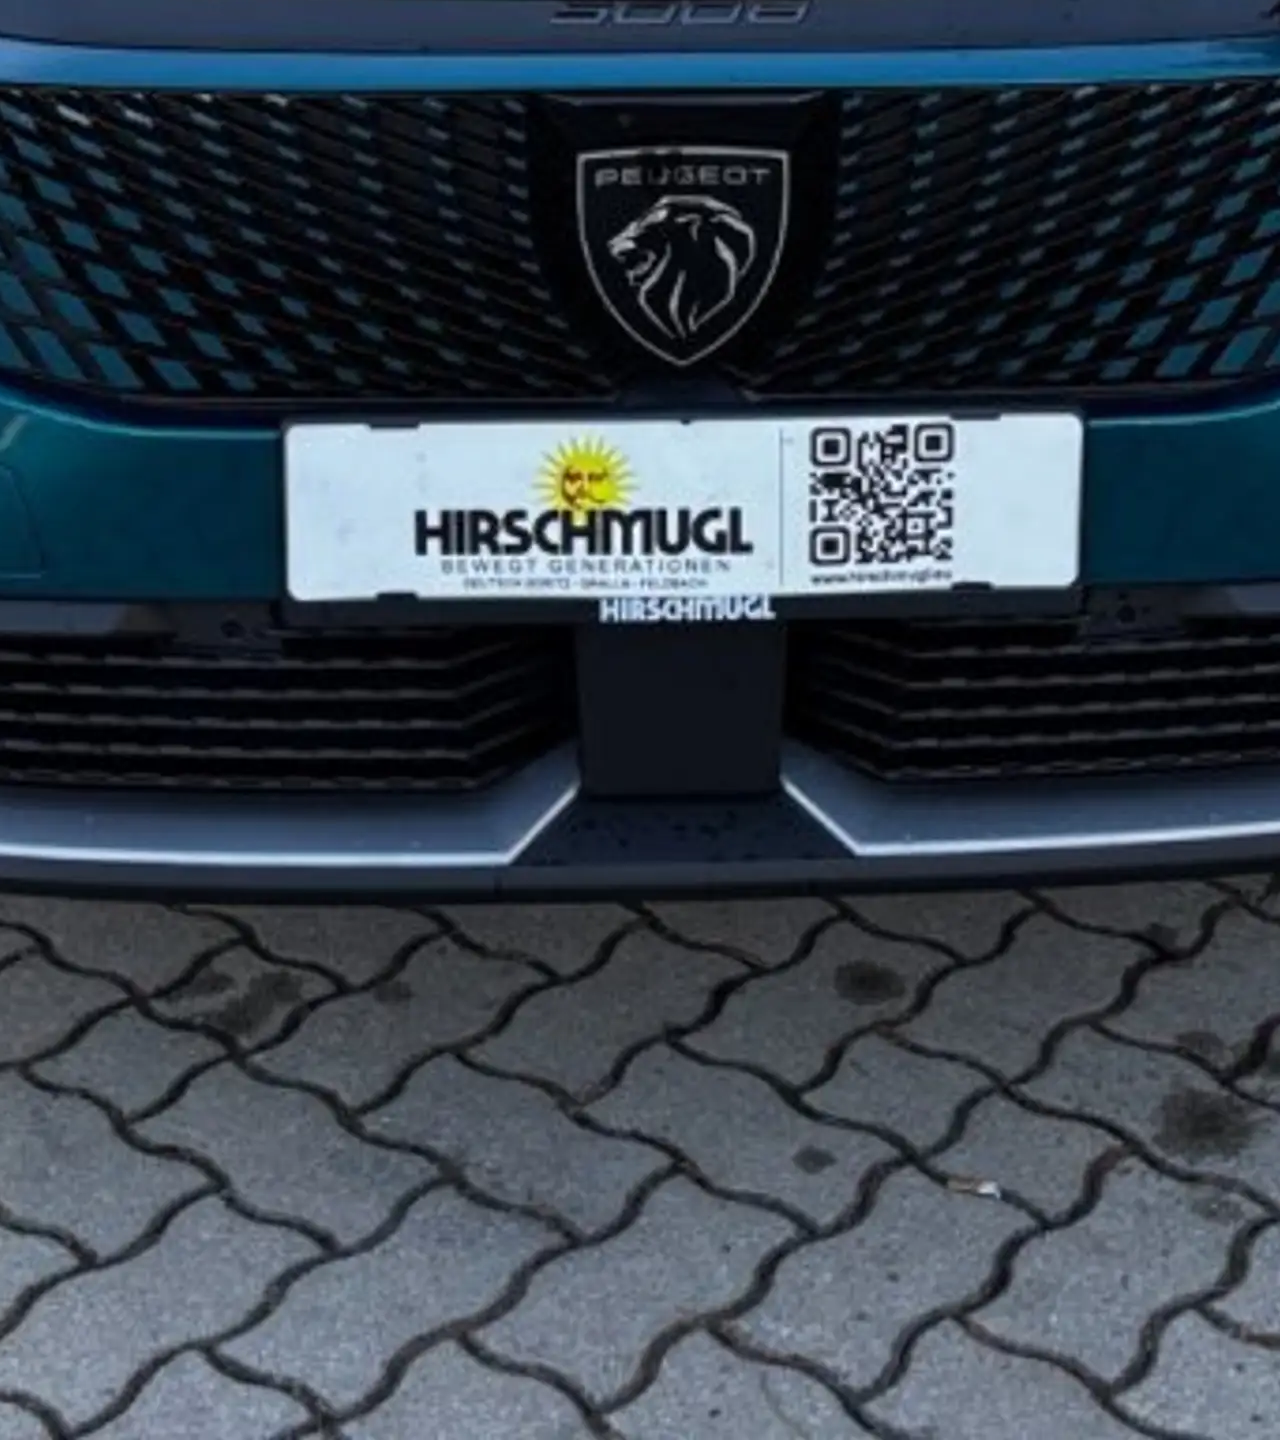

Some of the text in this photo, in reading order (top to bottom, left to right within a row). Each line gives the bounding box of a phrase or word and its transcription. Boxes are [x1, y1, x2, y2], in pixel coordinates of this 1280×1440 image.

[593, 164, 772, 187] PEUGEOT
[414, 508, 755, 555] HIRSCHMUGL
[440, 558, 732, 574] BEWEGT GENERATIONEN
[599, 594, 777, 623] HIRSCHMUGL
